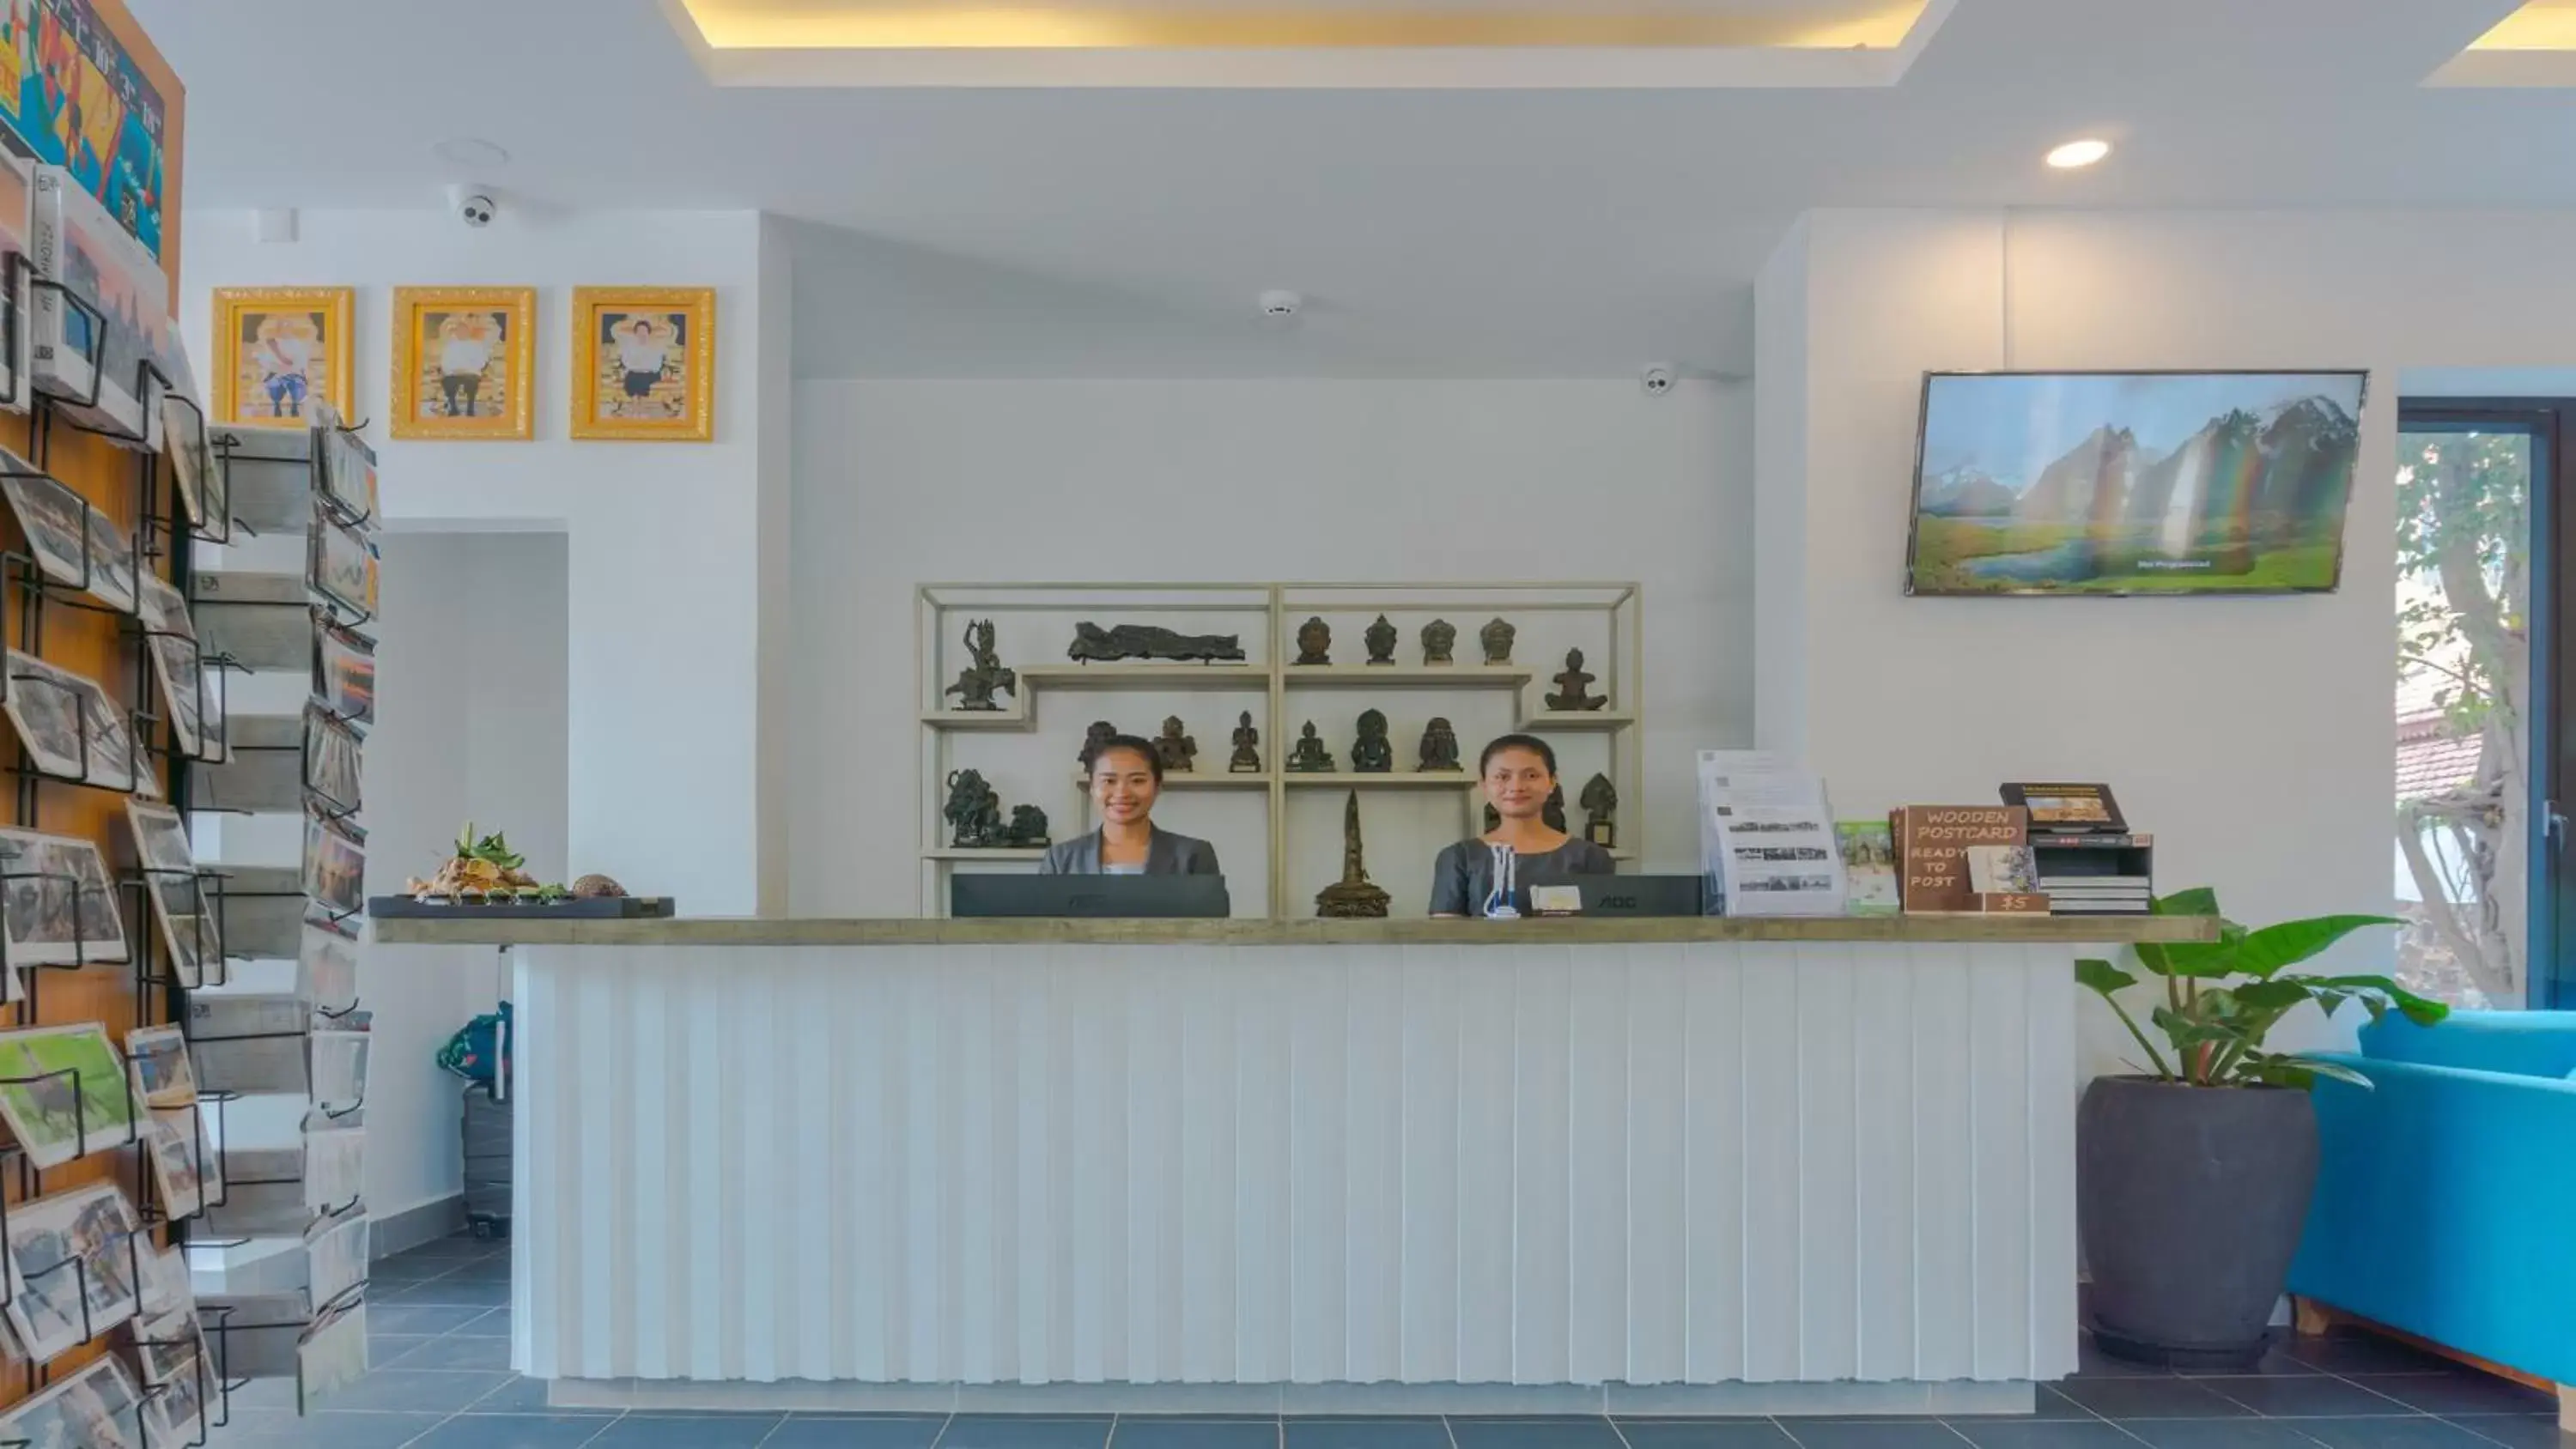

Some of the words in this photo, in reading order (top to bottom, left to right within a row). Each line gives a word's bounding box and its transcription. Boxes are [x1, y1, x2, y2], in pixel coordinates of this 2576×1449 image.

[1927, 810, 2009, 825] WOODEN
[1917, 826, 2018, 840] POSTCARD
[1911, 846, 1967, 859] READY
[1923, 862, 1947, 874] TO
[1911, 876, 1956, 888] POST
[1598, 895, 1637, 909] AOC
[2001, 894, 2030, 911] $5
